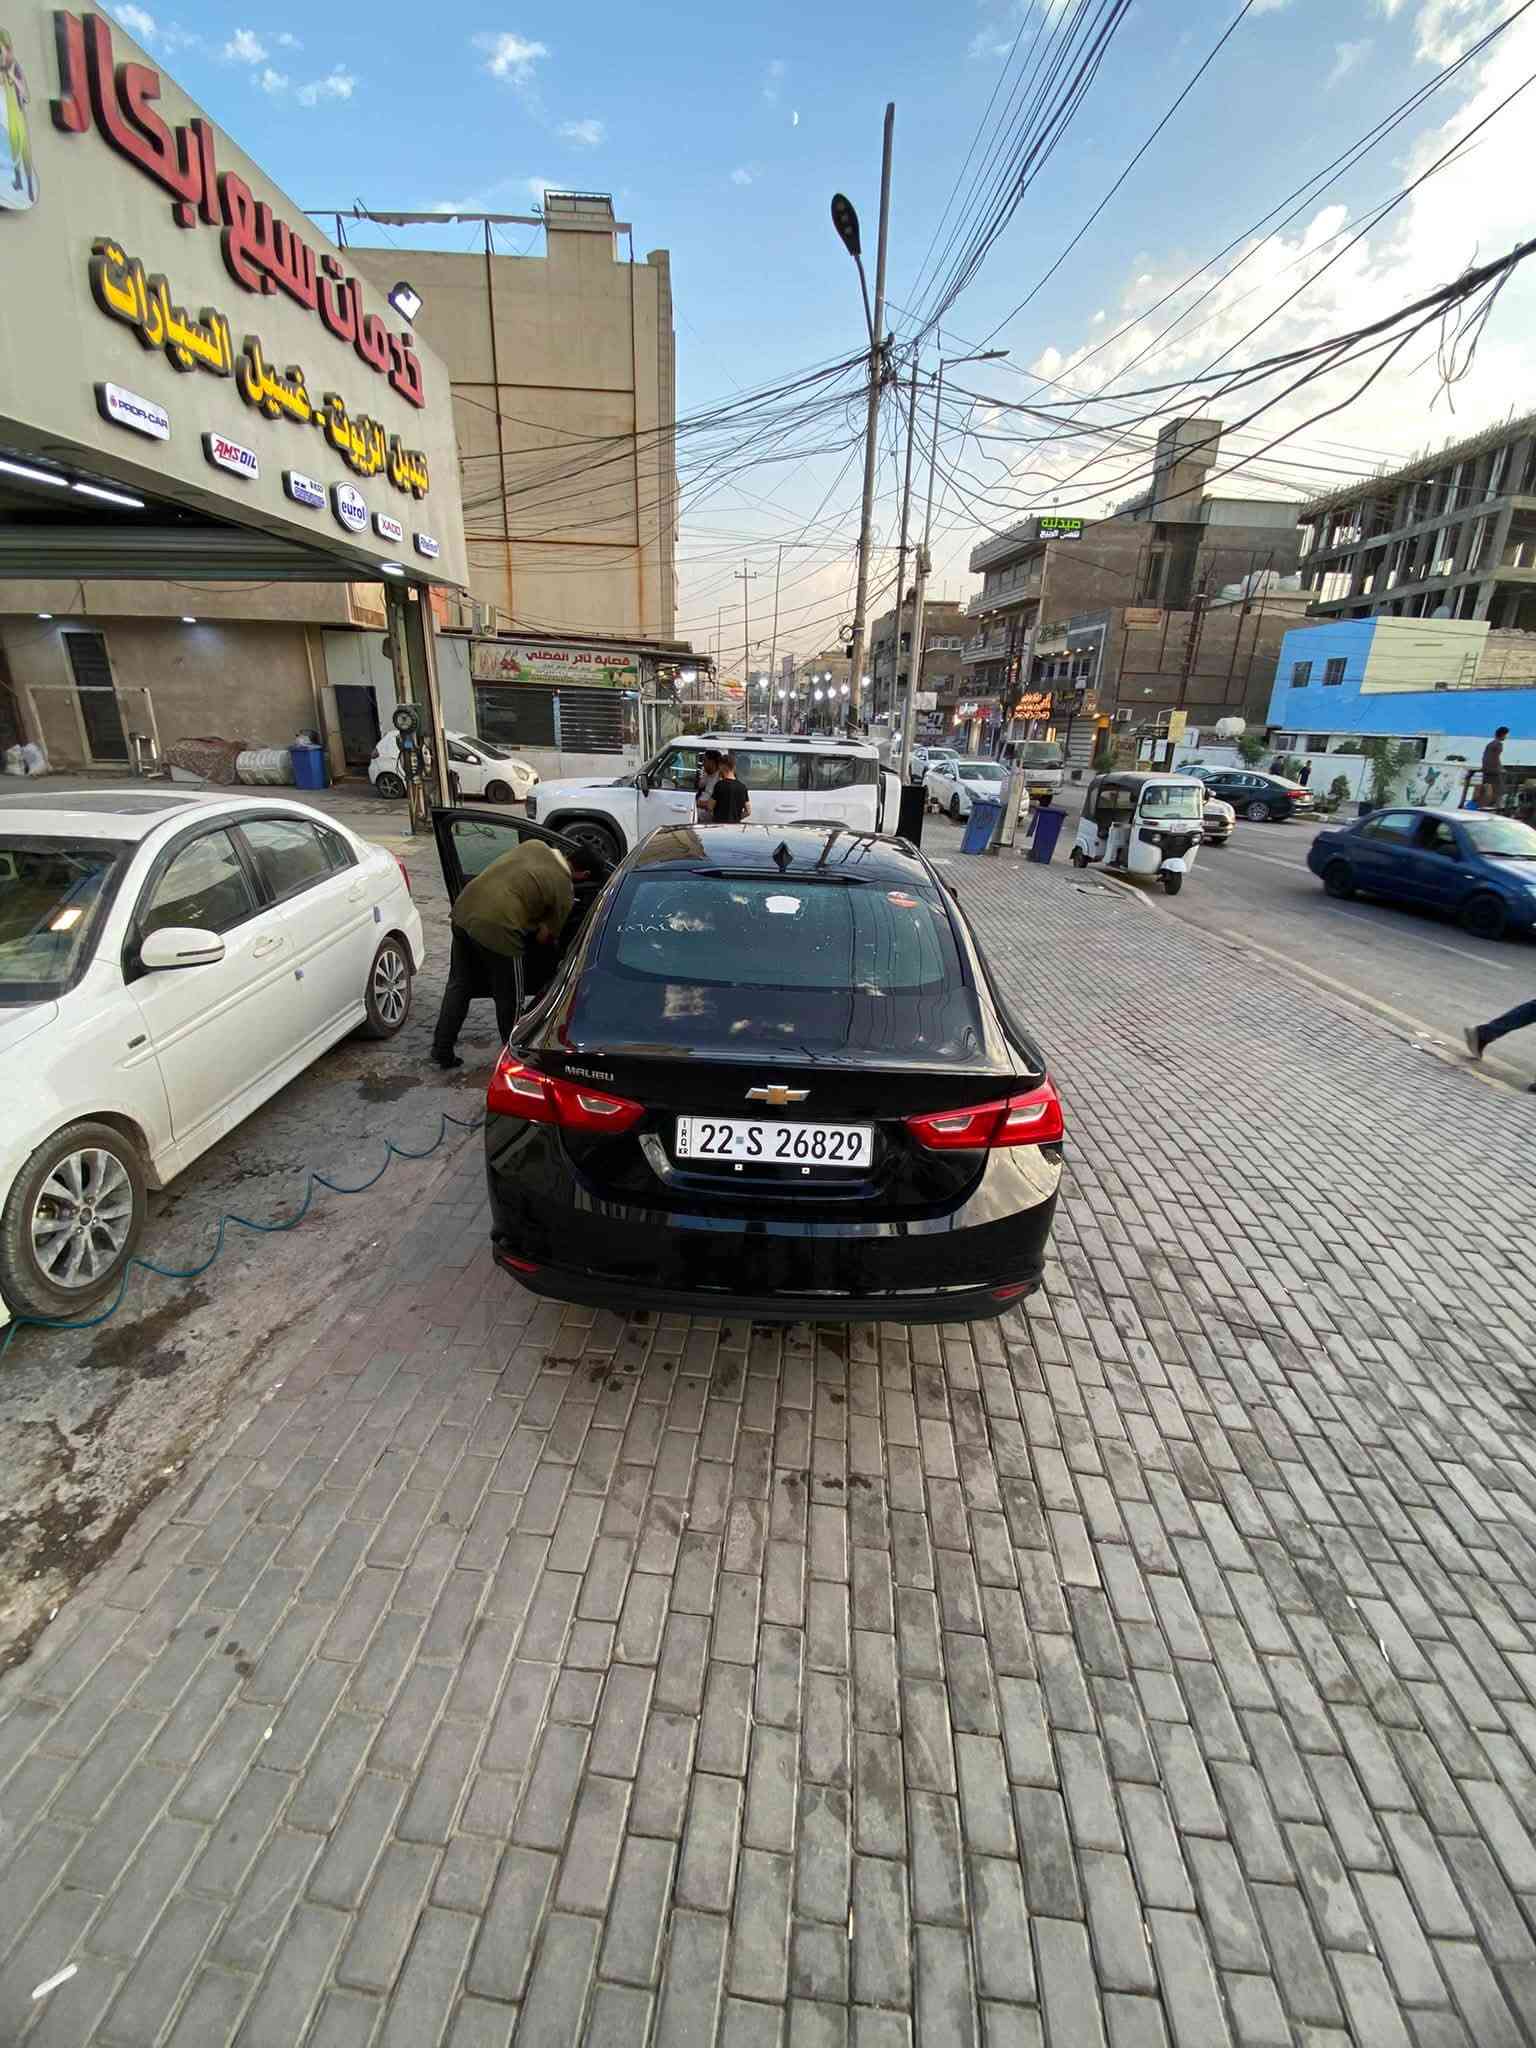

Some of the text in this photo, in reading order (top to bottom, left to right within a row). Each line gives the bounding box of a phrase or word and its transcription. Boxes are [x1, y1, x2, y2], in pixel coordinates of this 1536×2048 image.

[218, 171, 316, 310] سبع
[88, 237, 429, 500] تبديل الزيوت غسيل السيارات
[317, 255, 425, 408] خدمات
[341, 501, 366, 521] eurol
[564, 1064, 615, 1081] MALIBU
[700, 1124, 863, 1162] 22 S 26829
